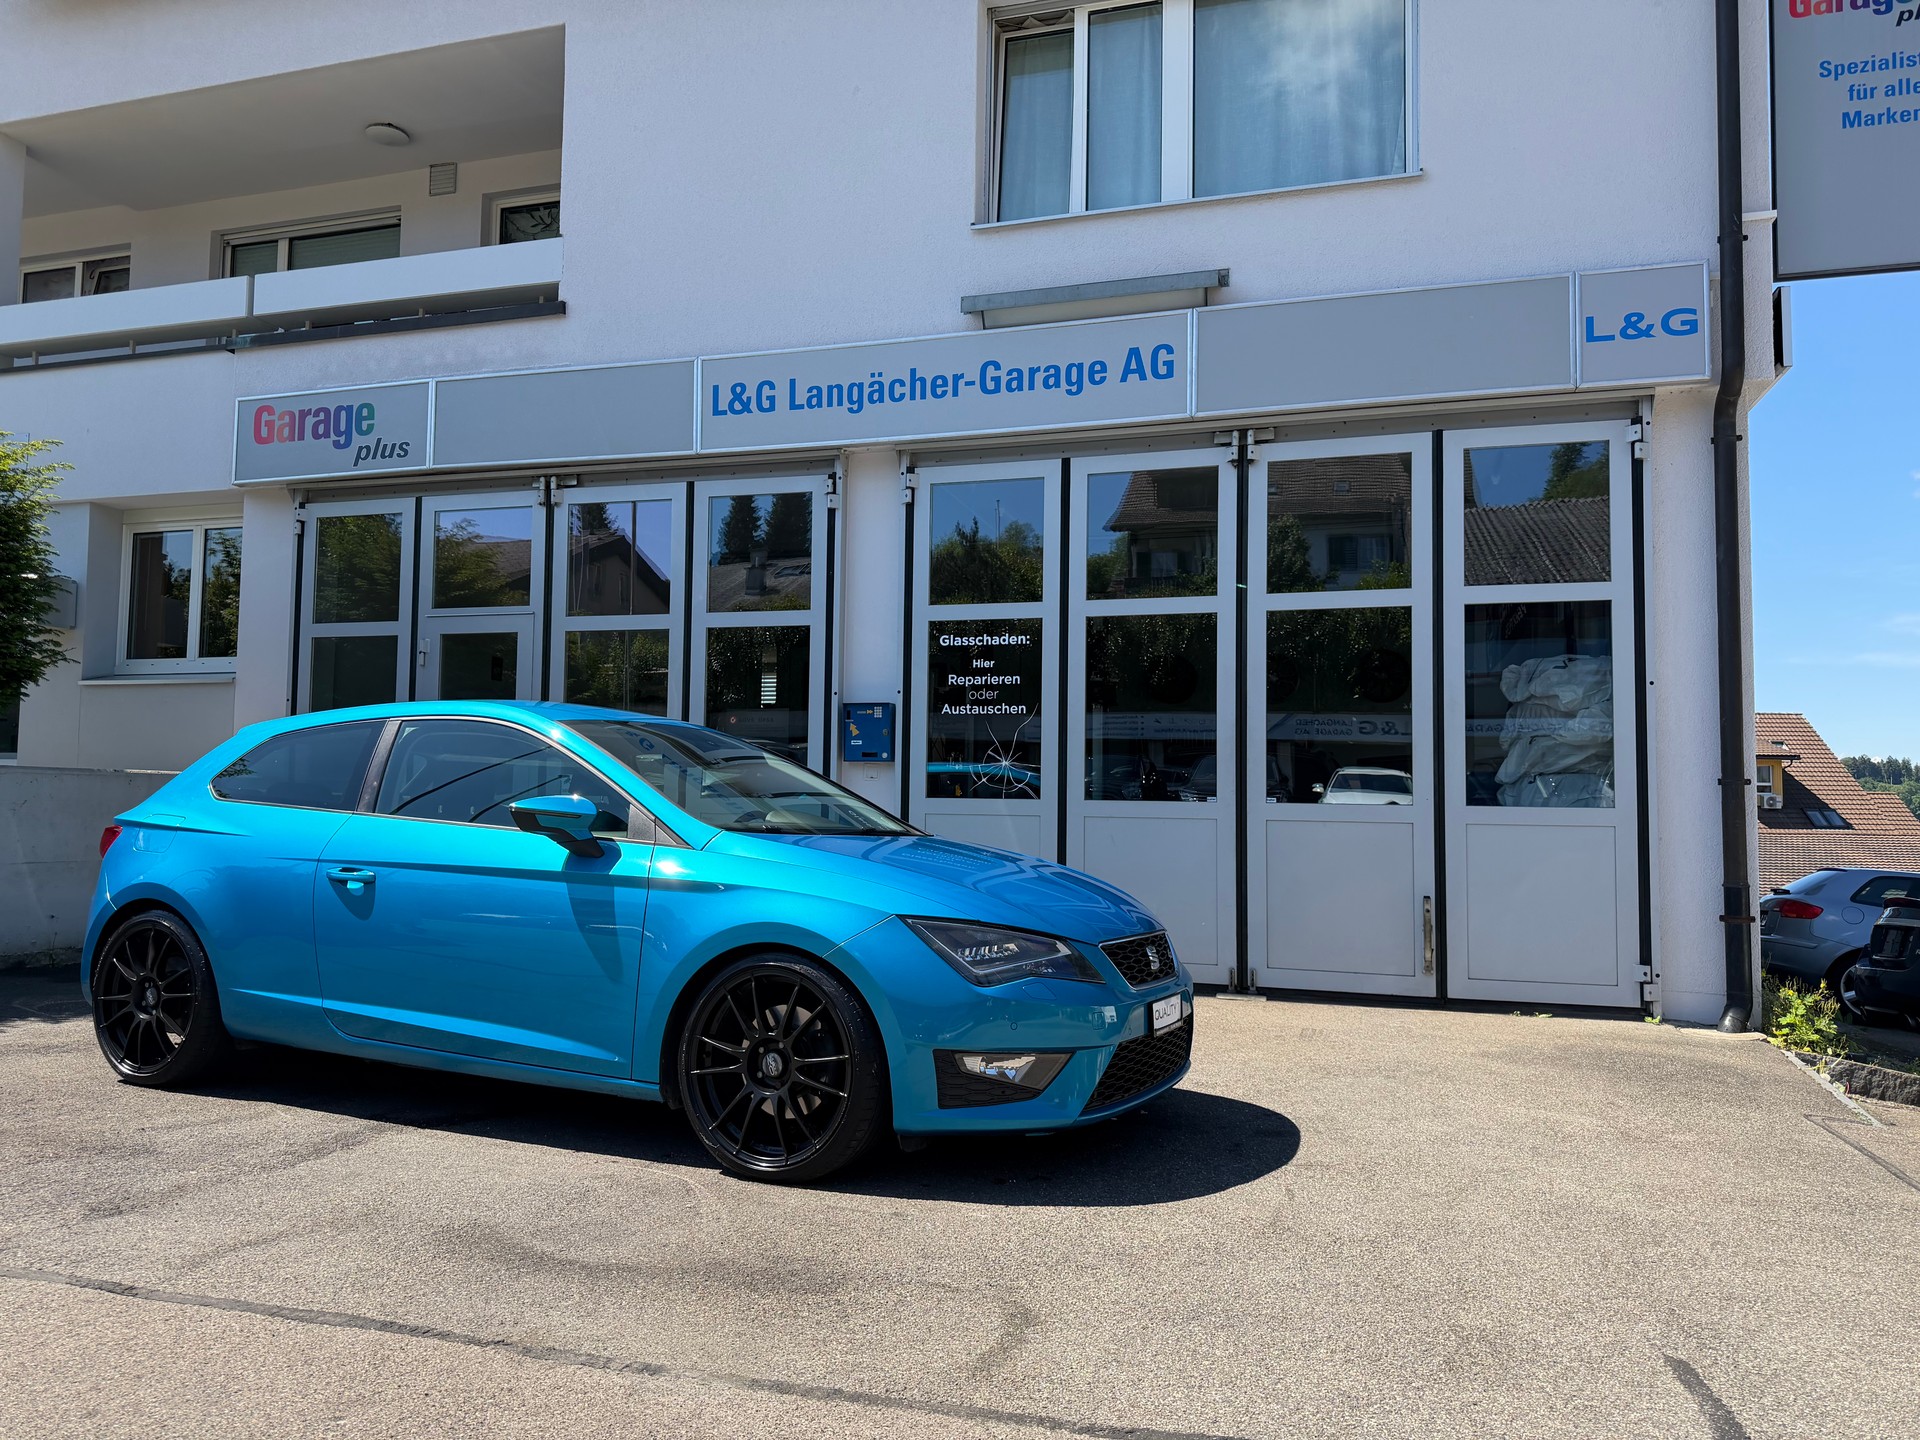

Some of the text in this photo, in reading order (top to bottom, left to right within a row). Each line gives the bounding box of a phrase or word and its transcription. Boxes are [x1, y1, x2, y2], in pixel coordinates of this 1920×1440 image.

[1789, 0, 1914, 18] Garag
[1848, 78, 1920, 102] für alle
[1585, 306, 1699, 343] L&G
[711, 342, 1176, 417] L&G Langächer-Garage AG
[253, 401, 376, 450] Garage
[352, 437, 411, 467] plus
[939, 633, 1031, 647] Glasschaden:
[972, 658, 995, 669] Hier
[948, 674, 1021, 687] Reparieren
[968, 688, 999, 700] oder
[941, 703, 1027, 715] Austauschen
